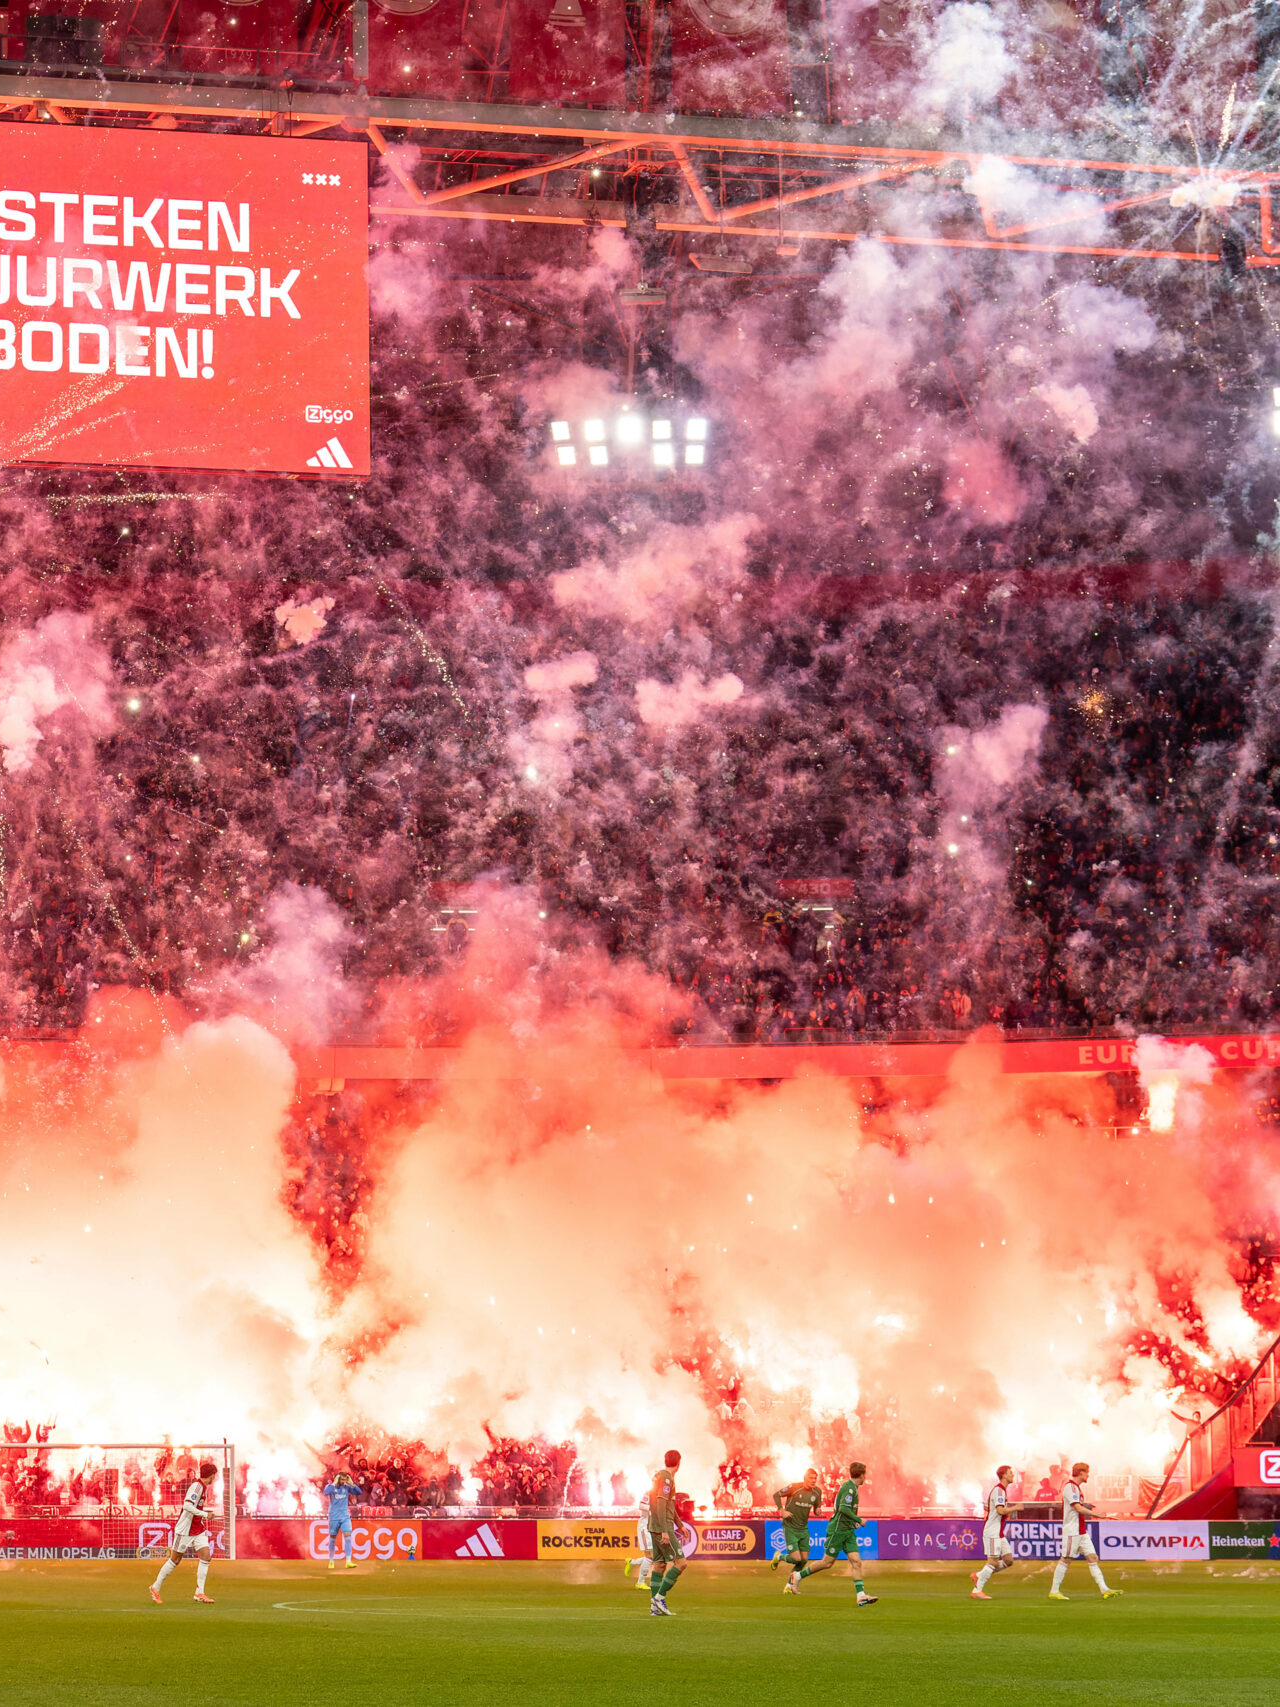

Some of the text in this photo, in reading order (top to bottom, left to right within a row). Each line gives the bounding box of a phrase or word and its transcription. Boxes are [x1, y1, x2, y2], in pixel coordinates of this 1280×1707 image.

[705, 1529, 742, 1540] ALLSAFE
[542, 1536, 630, 1548] ROCKSTARS
[701, 1543, 746, 1551] MINI OPSLAG
[1103, 1536, 1205, 1548] OLYMPIA
[1211, 1535, 1265, 1547] Heineken
[27, 1547, 58, 1560] MINI
[61, 1547, 117, 1560] OPSLAG
